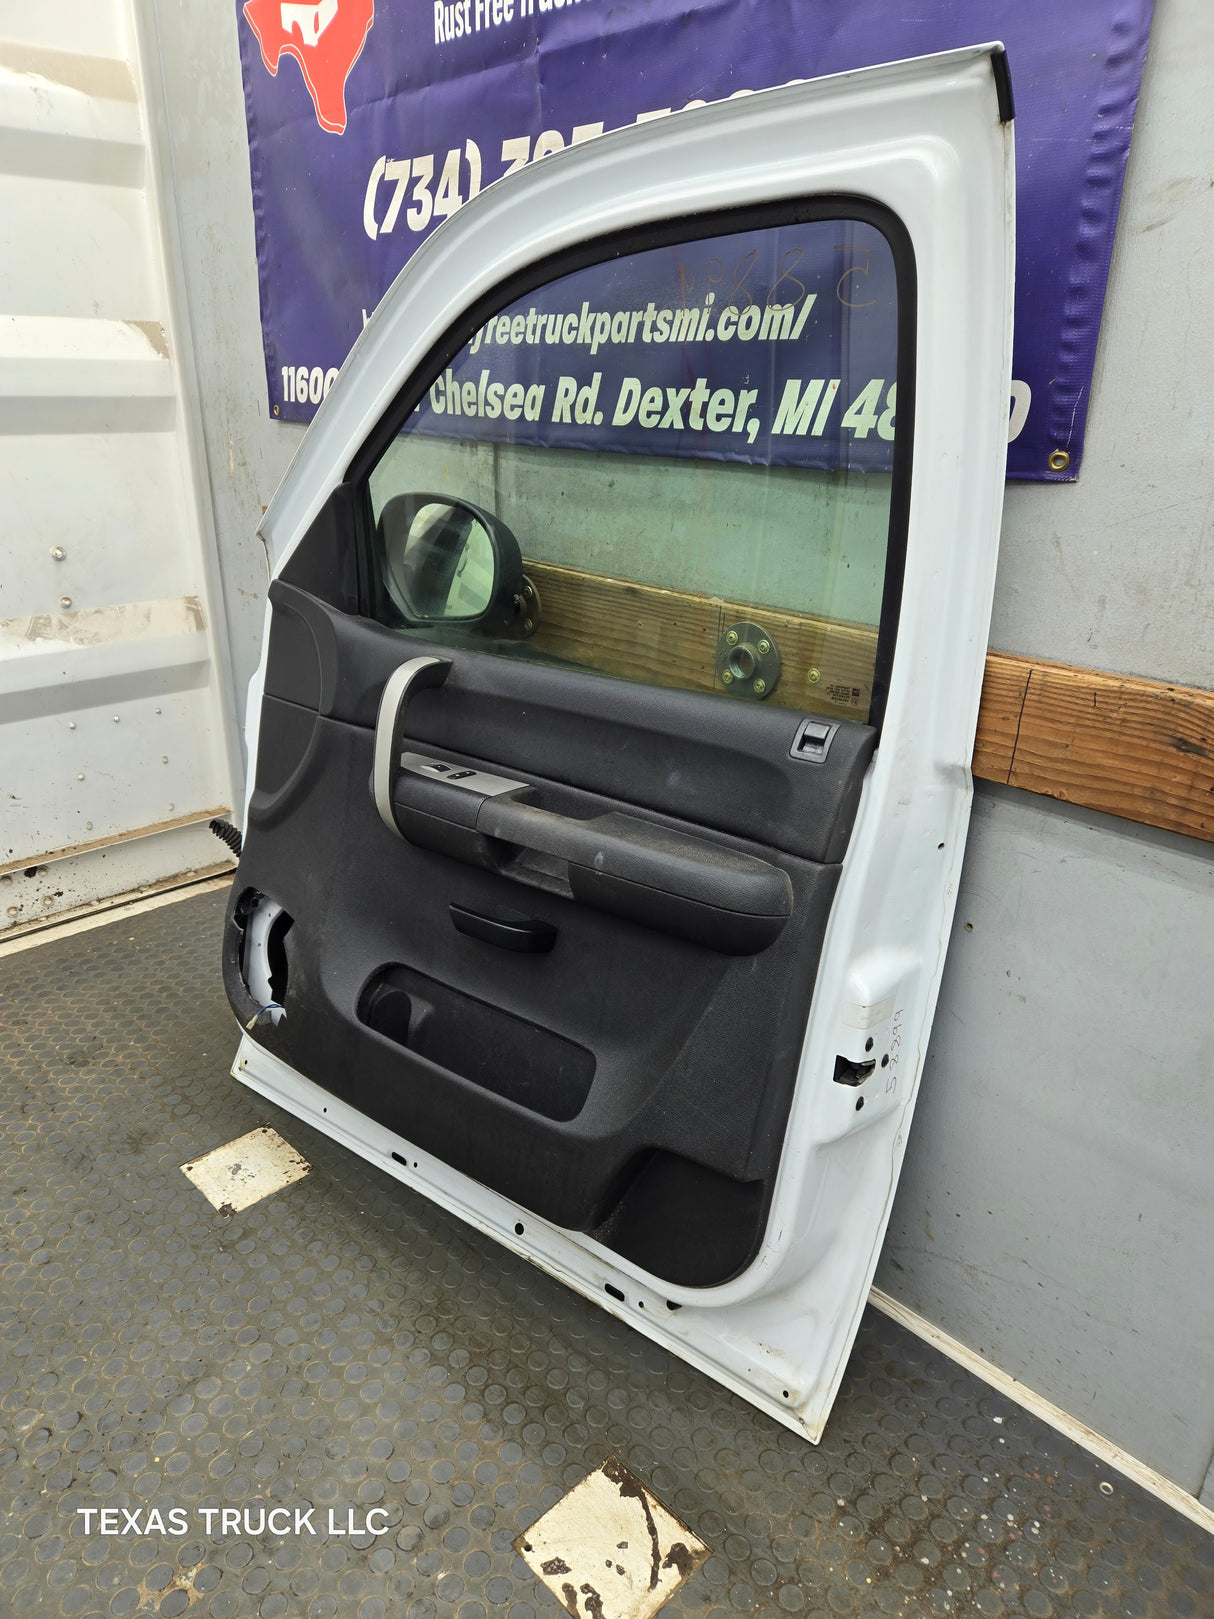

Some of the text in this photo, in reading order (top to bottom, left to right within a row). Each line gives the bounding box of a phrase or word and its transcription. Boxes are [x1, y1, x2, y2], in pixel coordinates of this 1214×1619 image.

[434, 0, 472, 45] Rust
[363, 138, 482, 241] (734)
[429, 368, 546, 422] Chelsea
[551, 372, 604, 425] Rd.
[612, 377, 761, 444] Dexter,
[771, 379, 841, 436] MI
